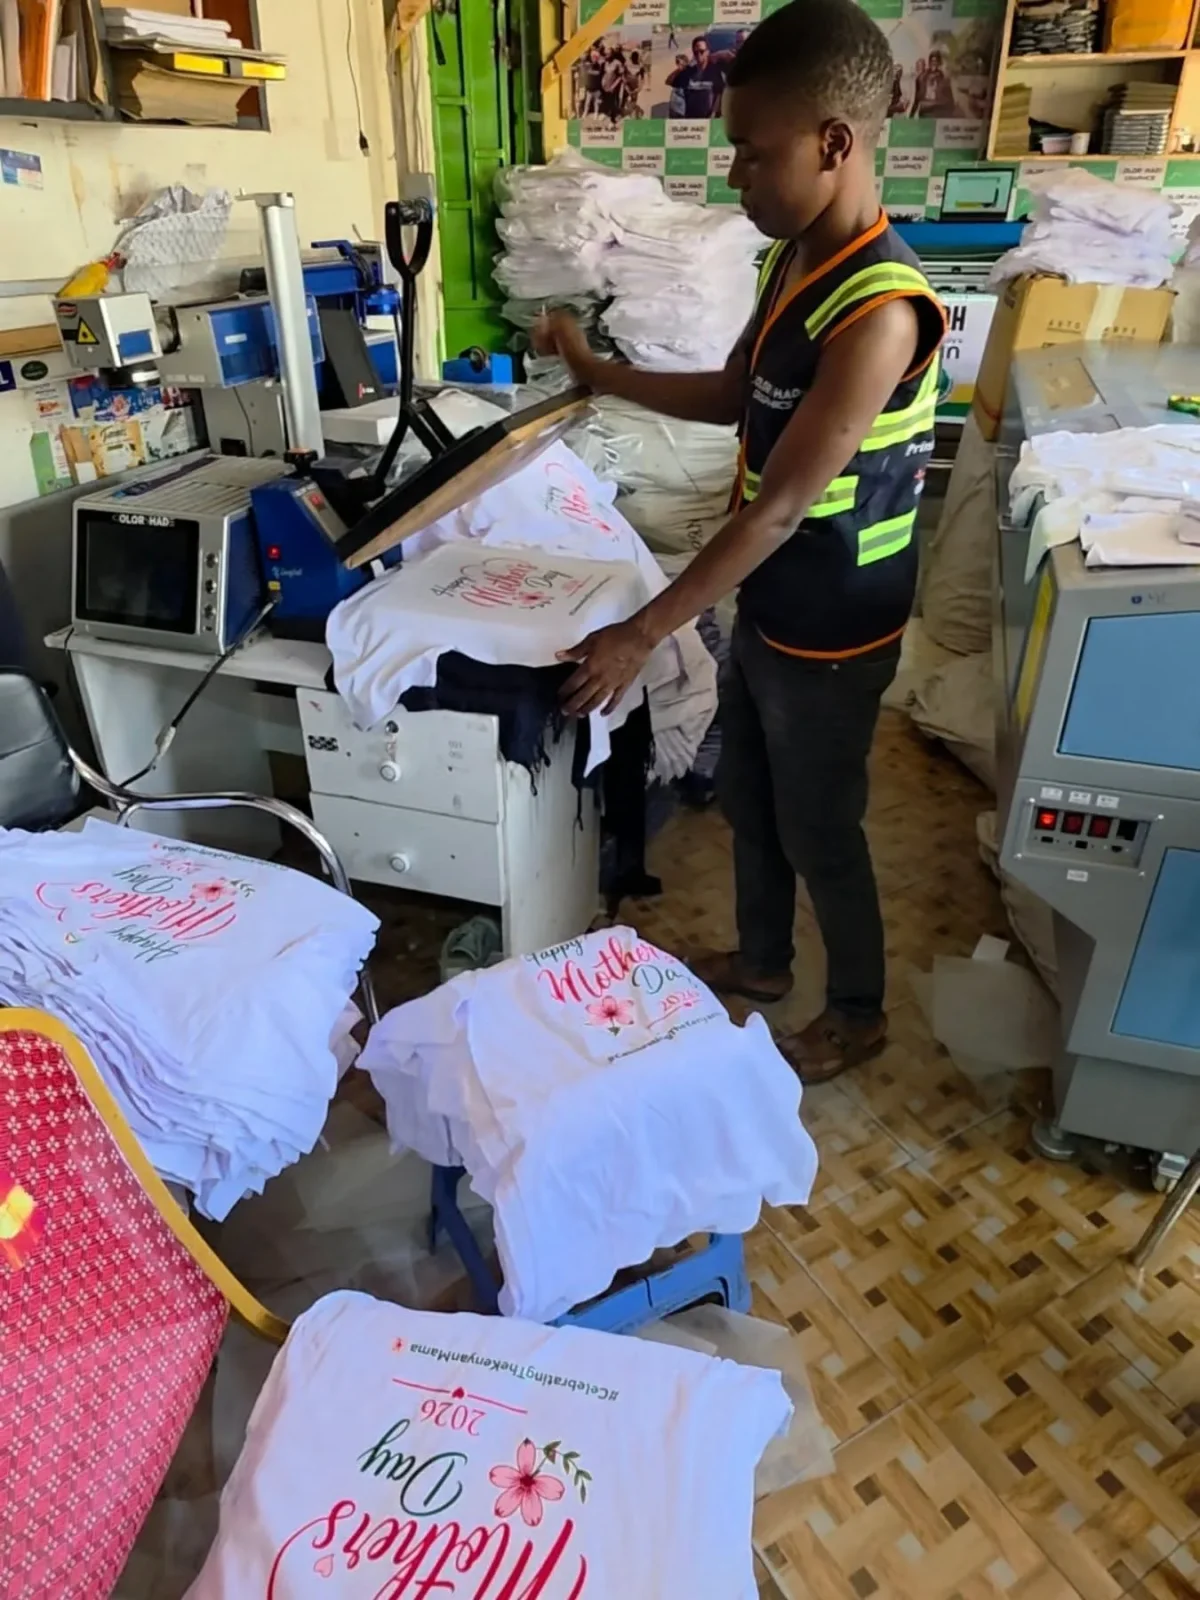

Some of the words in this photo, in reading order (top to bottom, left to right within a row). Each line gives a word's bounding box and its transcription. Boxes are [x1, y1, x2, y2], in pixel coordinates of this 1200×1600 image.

[409, 1342, 620, 1401] #CelebratingTheKenyanMama
[420, 1399, 487, 1437] 2026
[357, 1419, 468, 1517] Day
